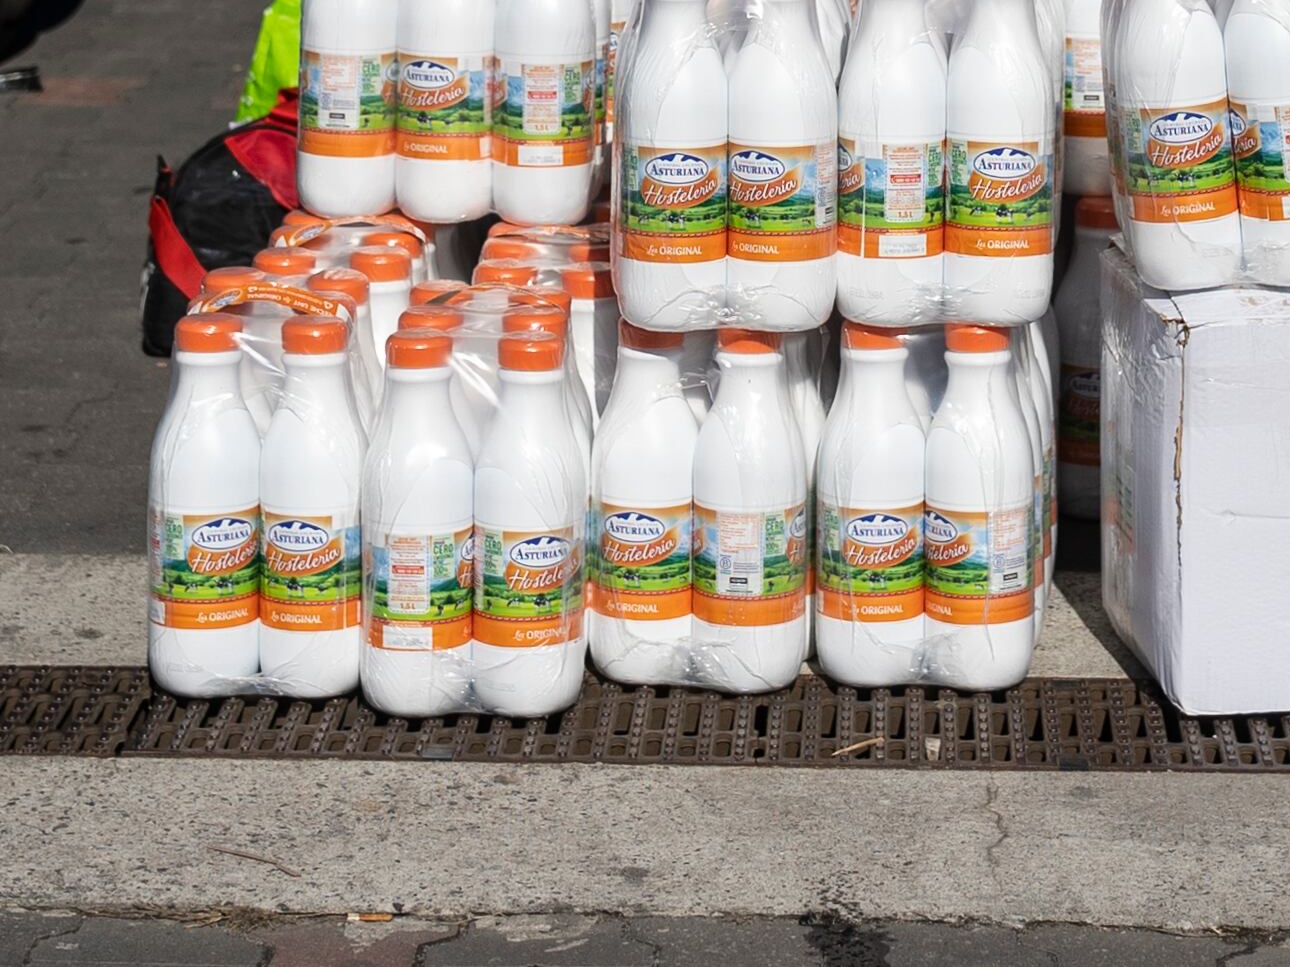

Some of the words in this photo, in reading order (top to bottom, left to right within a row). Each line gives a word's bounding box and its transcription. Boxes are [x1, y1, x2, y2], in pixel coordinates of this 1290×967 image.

[406, 69, 450, 83] ASTURIANA
[1154, 123, 1209, 137] ASTURIANA
[651, 163, 705, 177] ASTURIANA
[732, 159, 780, 175] ASTURIANA
[979, 158, 1031, 171] ASTURIANA
[1172, 201, 1216, 215] ORIGINAL
[659, 245, 703, 255] ORIGINAL
[739, 242, 780, 254] ORIGINAL
[986, 239, 1030, 249] ORIGINAL
[609, 520, 661, 536] ASTURIANA
[851, 524, 904, 537] ASTURIANA
[196, 528, 249, 543] ASTURIANA
[271, 530, 324, 544] ASTURIANA
[208, 607, 249, 622] ORIGINAL
[616, 602, 659, 613] ORIGINAL
[860, 604, 904, 615] ORIGINAL
[280, 612, 322, 624] ORIGINAL
